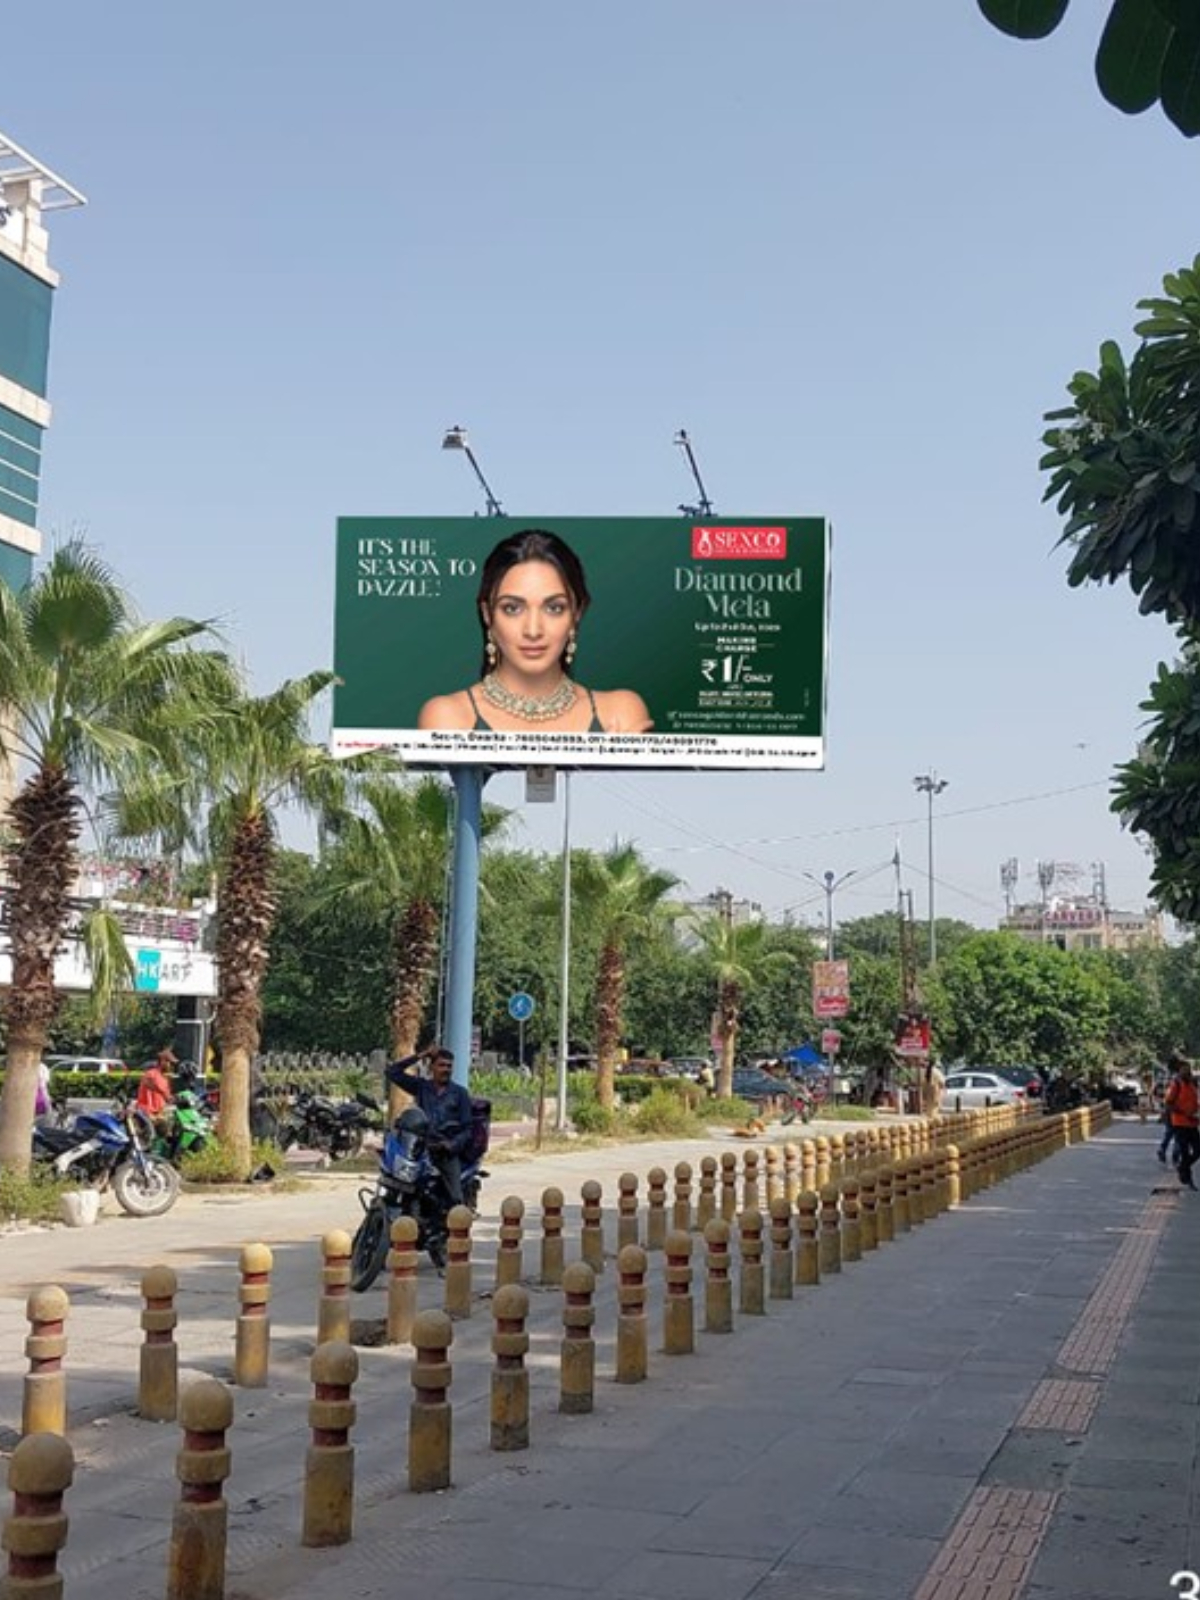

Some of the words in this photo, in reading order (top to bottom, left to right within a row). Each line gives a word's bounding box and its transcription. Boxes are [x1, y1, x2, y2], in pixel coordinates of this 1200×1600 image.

[358, 538, 393, 555] IT'S
[399, 538, 436, 556] THE
[714, 531, 780, 547] SENCO
[358, 558, 440, 576] SEASON
[449, 558, 476, 576] TO
[675, 566, 802, 592] Diamond
[706, 593, 771, 618] Mela
[742, 674, 773, 683] ONLY
